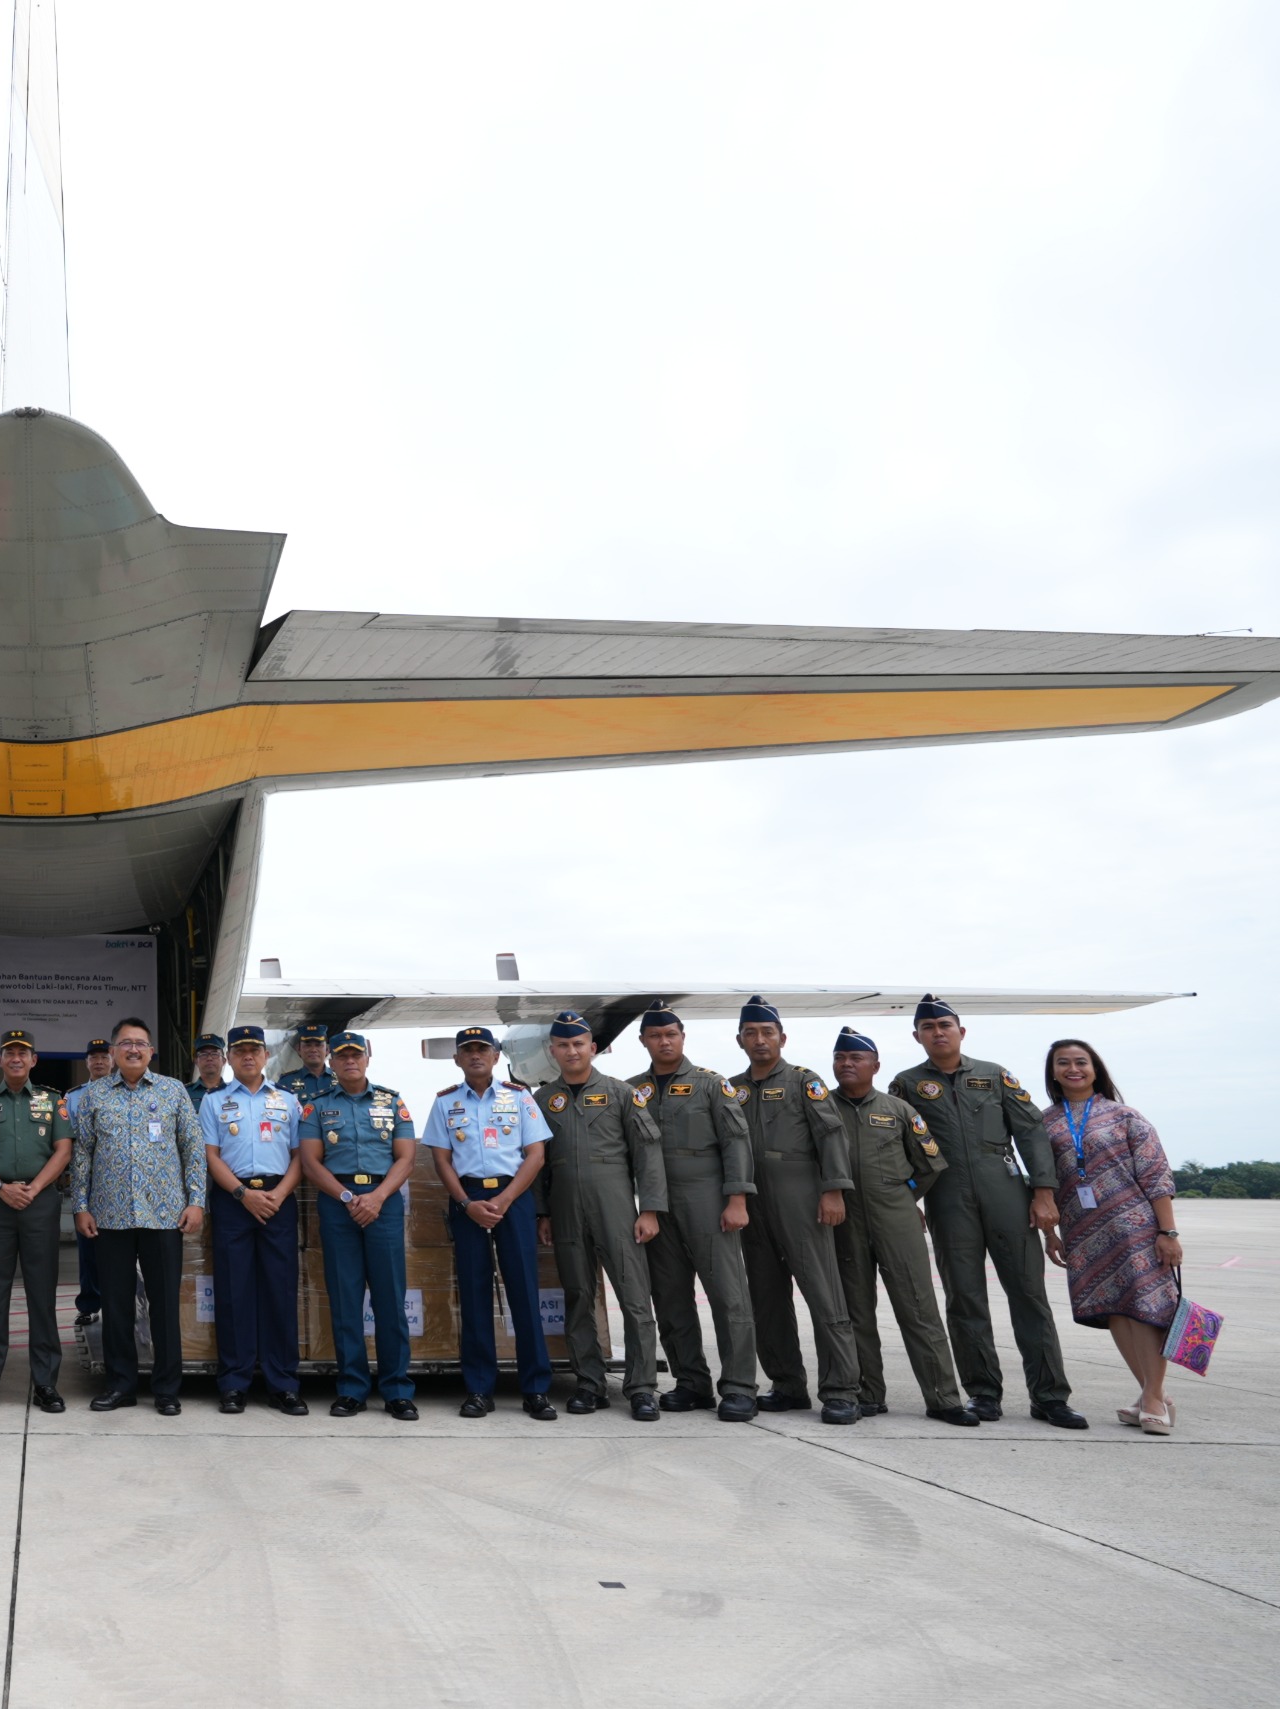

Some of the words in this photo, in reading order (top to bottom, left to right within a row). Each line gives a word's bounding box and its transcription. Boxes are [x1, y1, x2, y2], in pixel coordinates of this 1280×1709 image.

[105, 939, 128, 948] bakti
[18, 973, 53, 981] Bantuan
[92, 974, 114, 982] Alam
[36, 983, 75, 991] Laki-laki,
[76, 983, 102, 991] Flores
[104, 984, 129, 992] Timur,
[131, 984, 148, 992] NTT
[406, 1315, 418, 1324] CA
